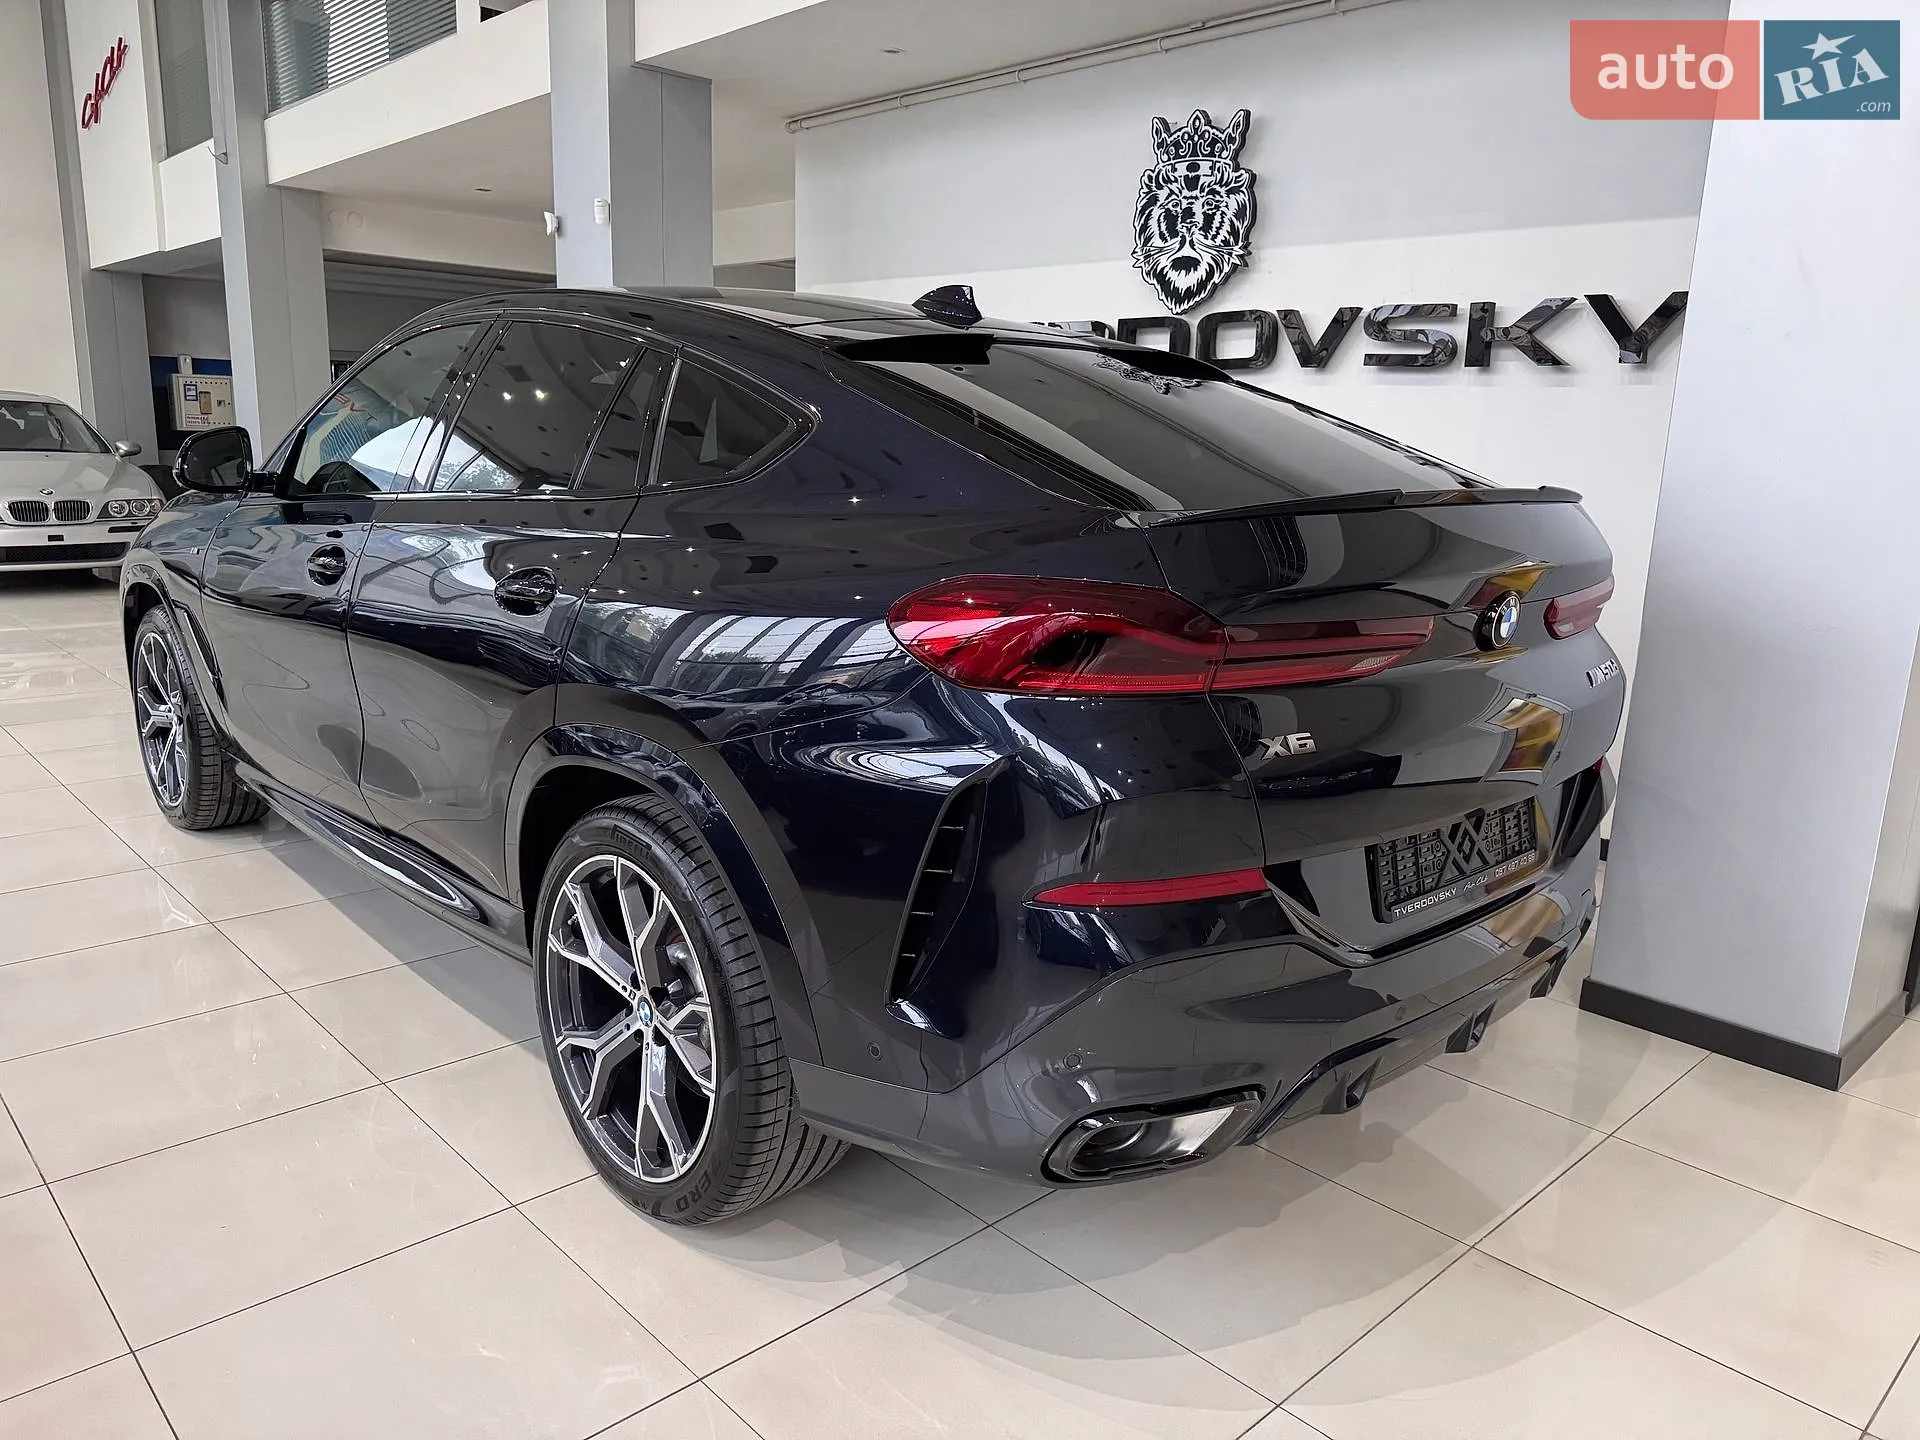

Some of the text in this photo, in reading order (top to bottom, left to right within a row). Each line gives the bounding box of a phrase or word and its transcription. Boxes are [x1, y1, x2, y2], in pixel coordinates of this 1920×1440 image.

[1048, 291, 1689, 370] DOVSKY
[1257, 732, 1317, 760] X6
[1394, 887, 1457, 917] TVERDOVSKY
